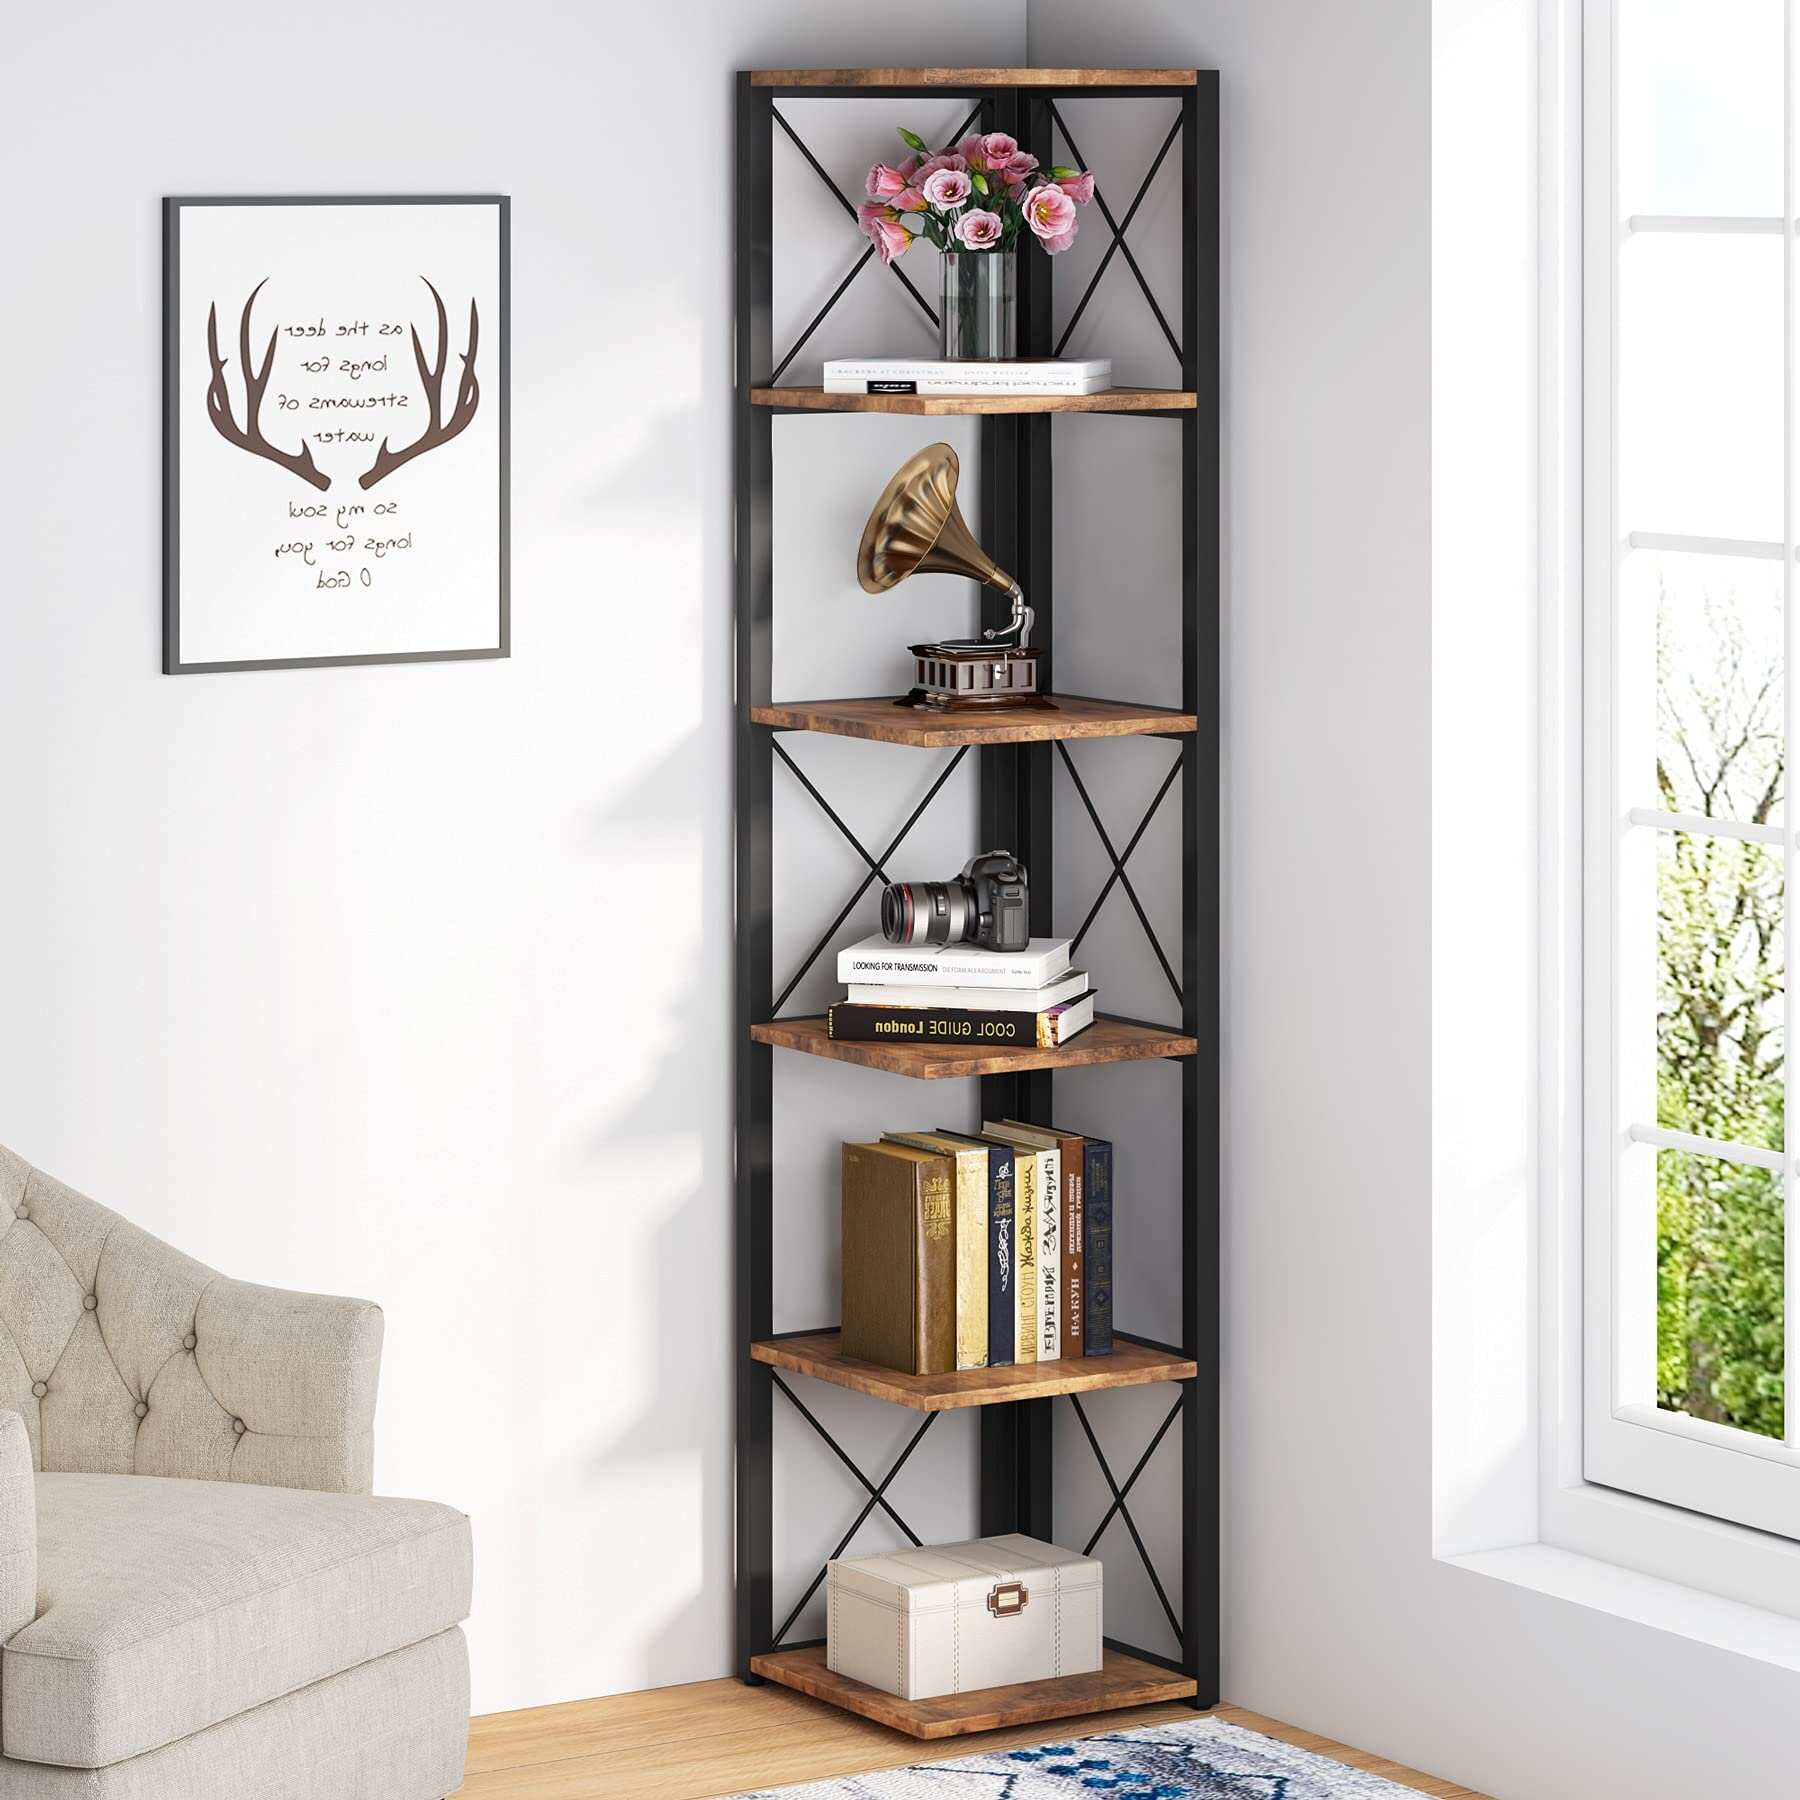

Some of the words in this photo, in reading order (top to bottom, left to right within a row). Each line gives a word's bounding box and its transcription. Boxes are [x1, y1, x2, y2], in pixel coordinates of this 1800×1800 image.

[852, 961, 880, 971] LOOKING
[881, 962, 894, 971] FOR
[894, 962, 938, 973] TRANSMISSION
[1022, 1164, 1035, 1214] жизни
[1020, 1215, 1035, 1268] Жажда
[1020, 1271, 1035, 1308] СТОУН
[1020, 1312, 1035, 1355] ИРВИНГ
